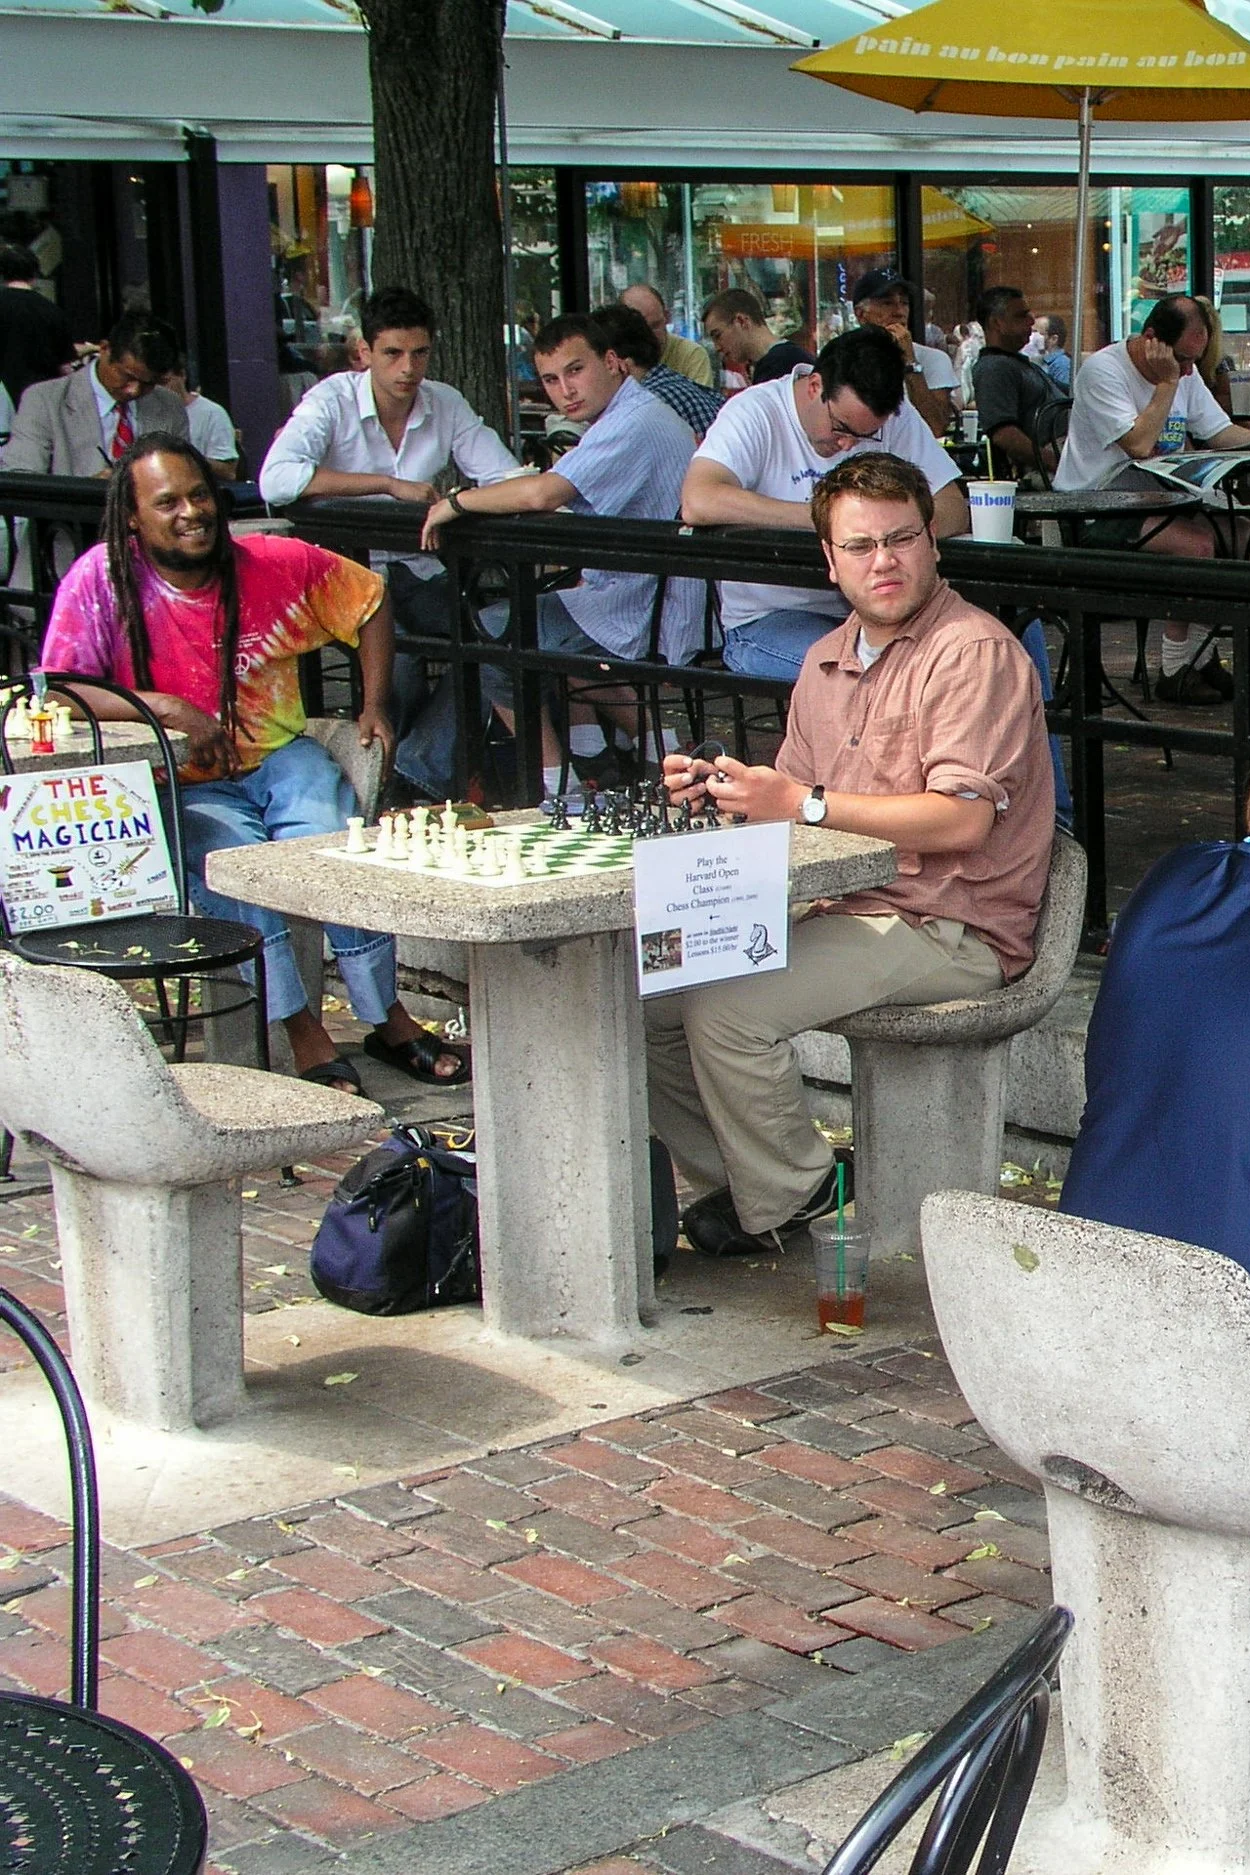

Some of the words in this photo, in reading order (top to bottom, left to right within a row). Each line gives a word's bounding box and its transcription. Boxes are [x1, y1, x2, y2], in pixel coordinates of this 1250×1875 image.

[855, 35, 931, 56] pain
[939, 45, 981, 61] au
[985, 45, 1049, 65] bon
[1053, 52, 1129, 70] pain
[1136, 55, 1178, 67] au
[1184, 50, 1247, 67] bon
[740, 232, 793, 253] FRESH
[984, 493, 1011, 506] bon
[43, 775, 107, 798] THE
[31, 794, 132, 826] CHESS
[13, 813, 151, 851] MAGICIAN
[696, 857, 713, 868] Play
[715, 856, 728, 865] the
[685, 869, 717, 883] Harvard
[718, 868, 739, 879] Open
[692, 884, 714, 895] Class
[666, 902, 689, 913] Chess
[690, 896, 730, 909] Champion
